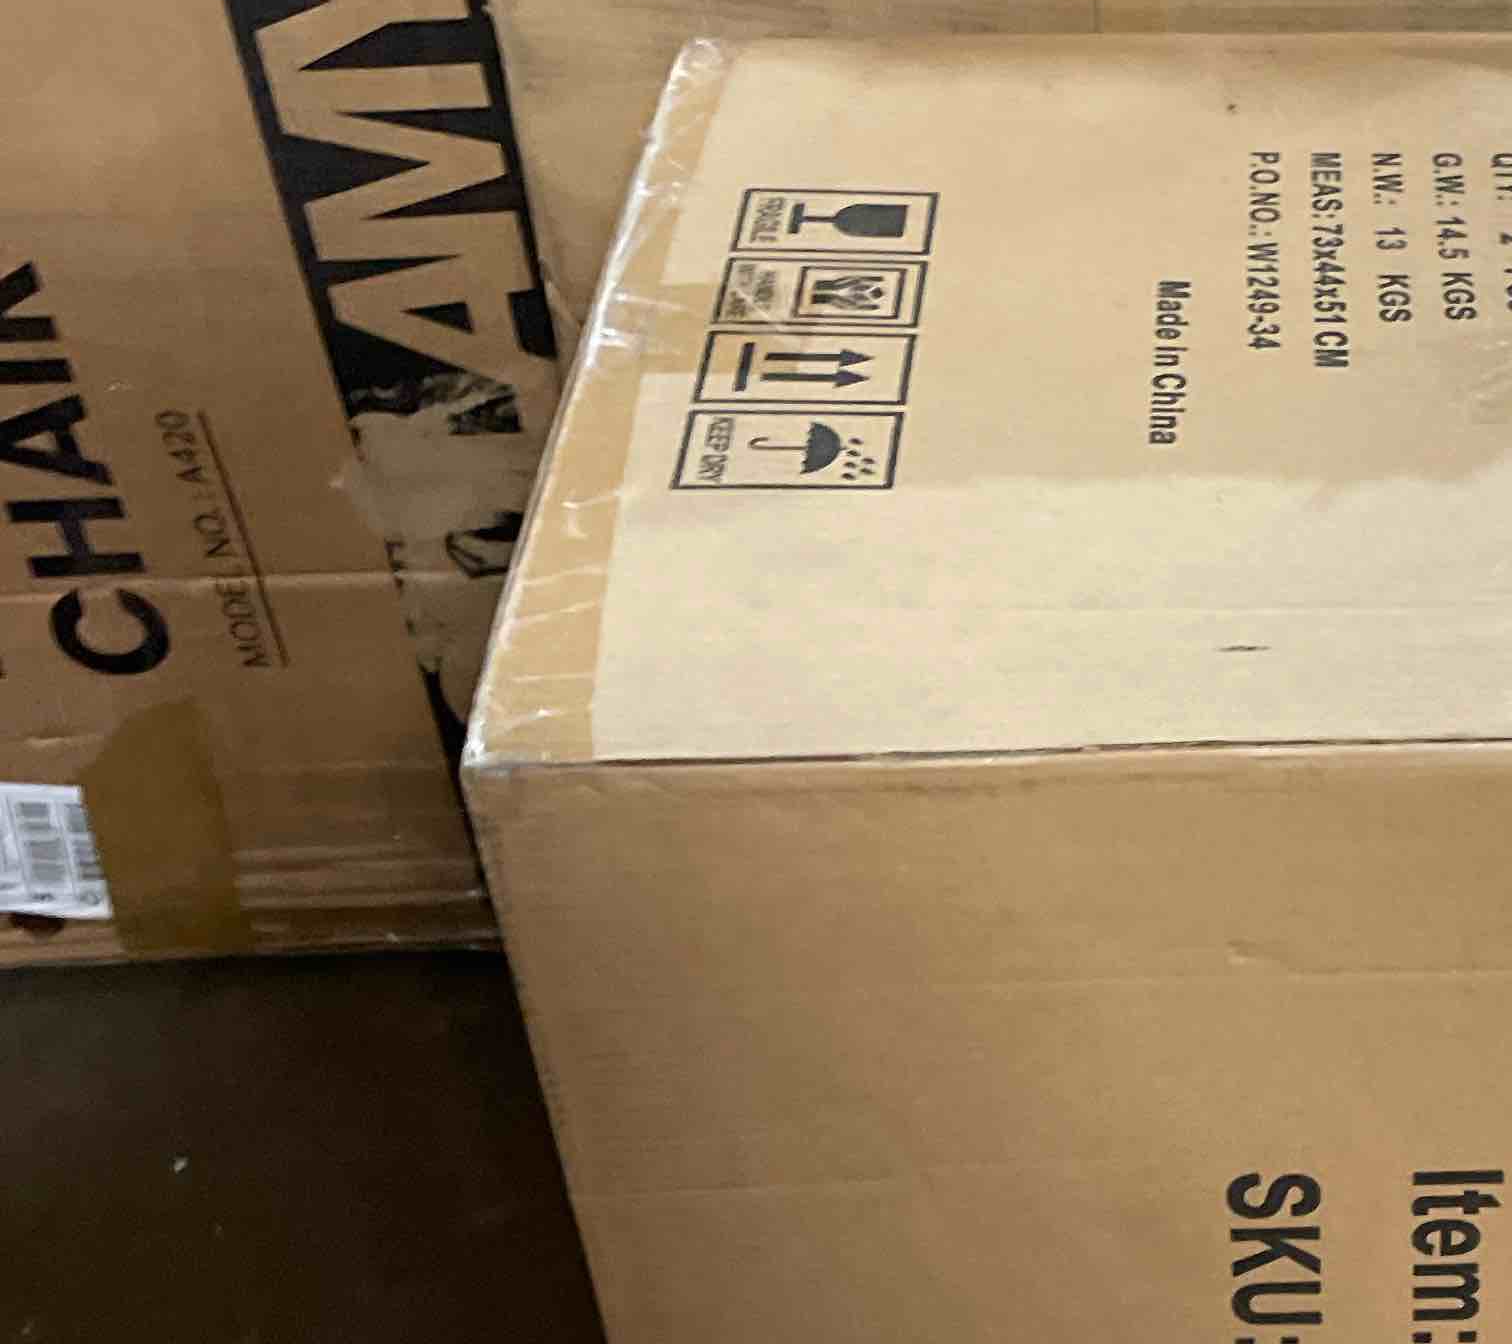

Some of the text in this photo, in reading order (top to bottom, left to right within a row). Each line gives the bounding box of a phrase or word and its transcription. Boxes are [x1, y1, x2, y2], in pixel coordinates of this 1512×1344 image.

[1246, 241, 1281, 350] W1249-34
[1372, 153, 1413, 324] N.W.: 13 KGS
[1431, 152, 1478, 321] G.W.: 14.5 KGS
[1154, 280, 1191, 340] Made
[698, 416, 734, 484] KEEP DRY
[1410, 1168, 1505, 1344] Item:
